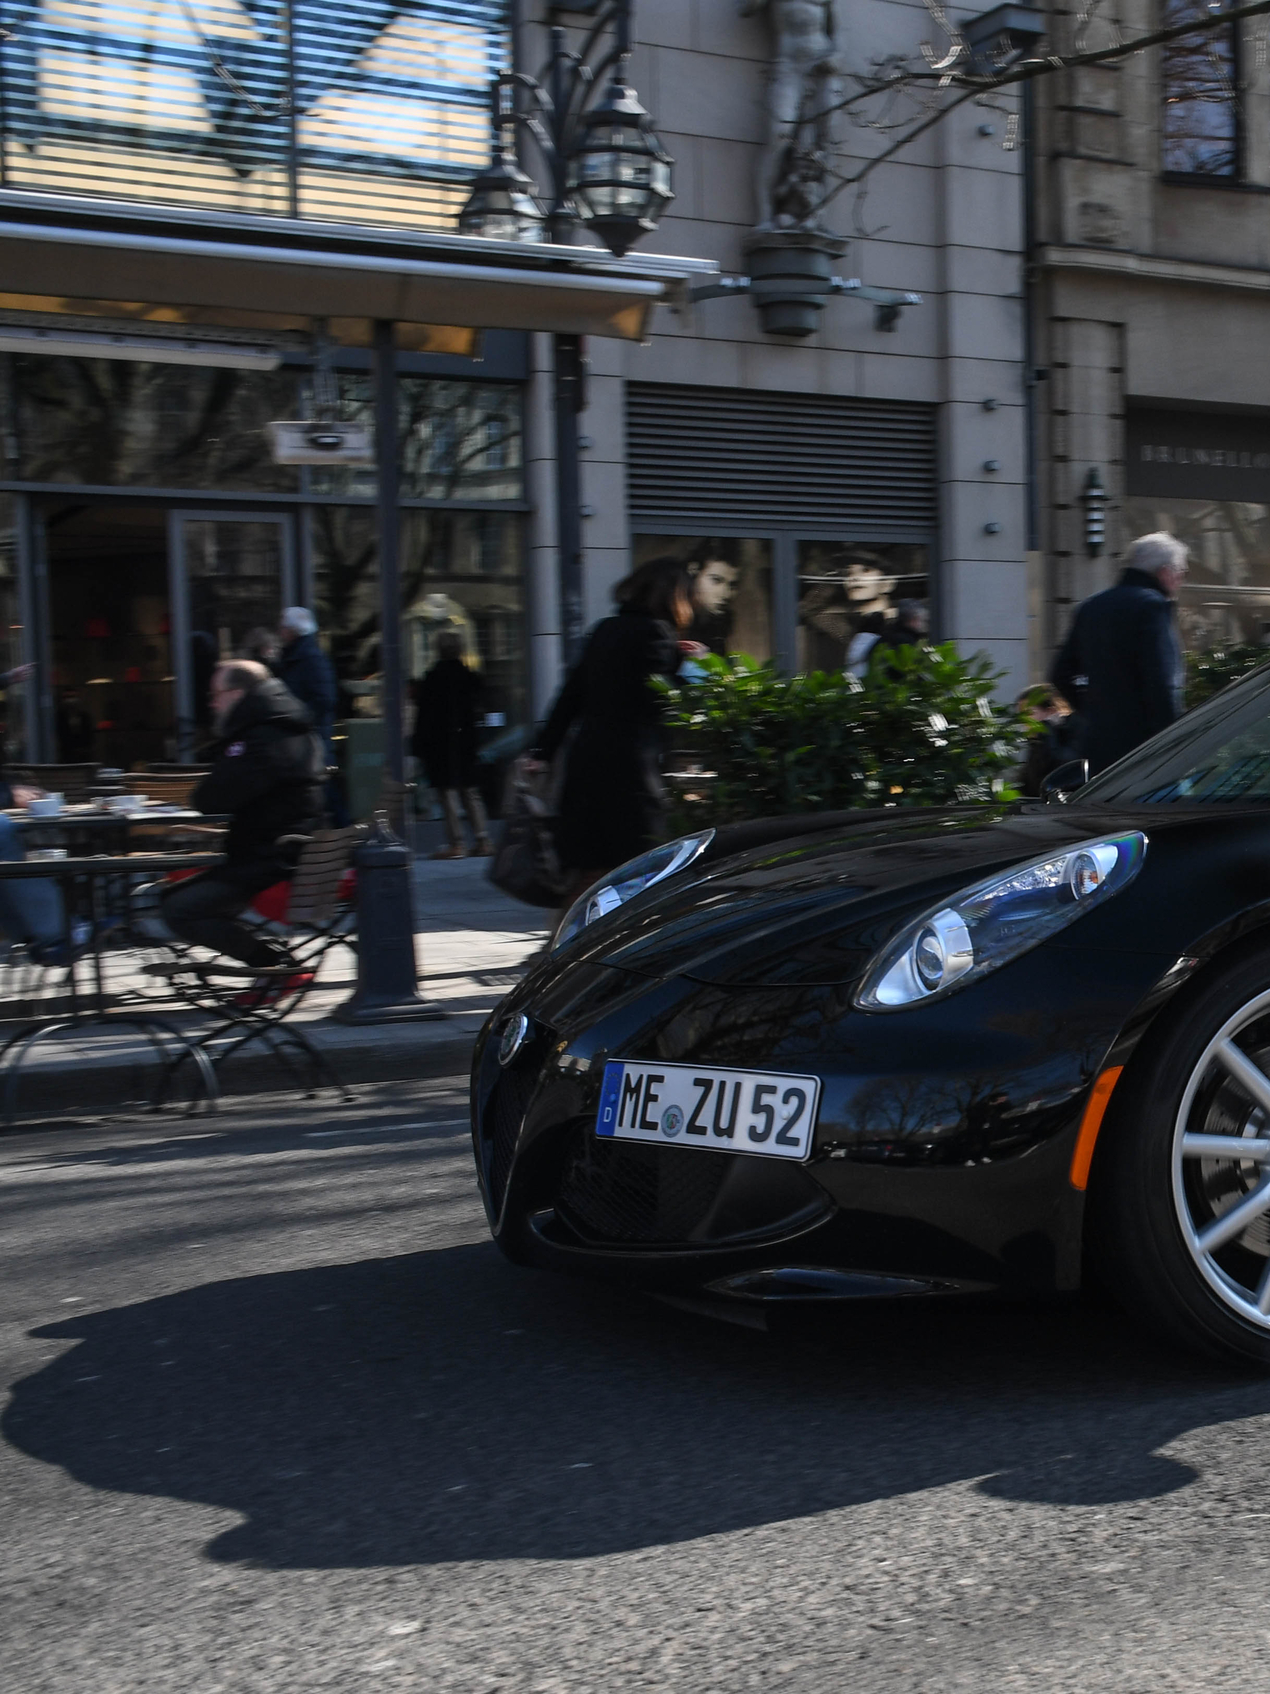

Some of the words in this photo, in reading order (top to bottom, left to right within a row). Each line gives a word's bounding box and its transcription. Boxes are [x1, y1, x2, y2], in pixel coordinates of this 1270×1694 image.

[603, 1107, 612, 1122] D
[618, 1072, 665, 1131] ME
[686, 1077, 742, 1138] ZU
[748, 1084, 806, 1147] 52
